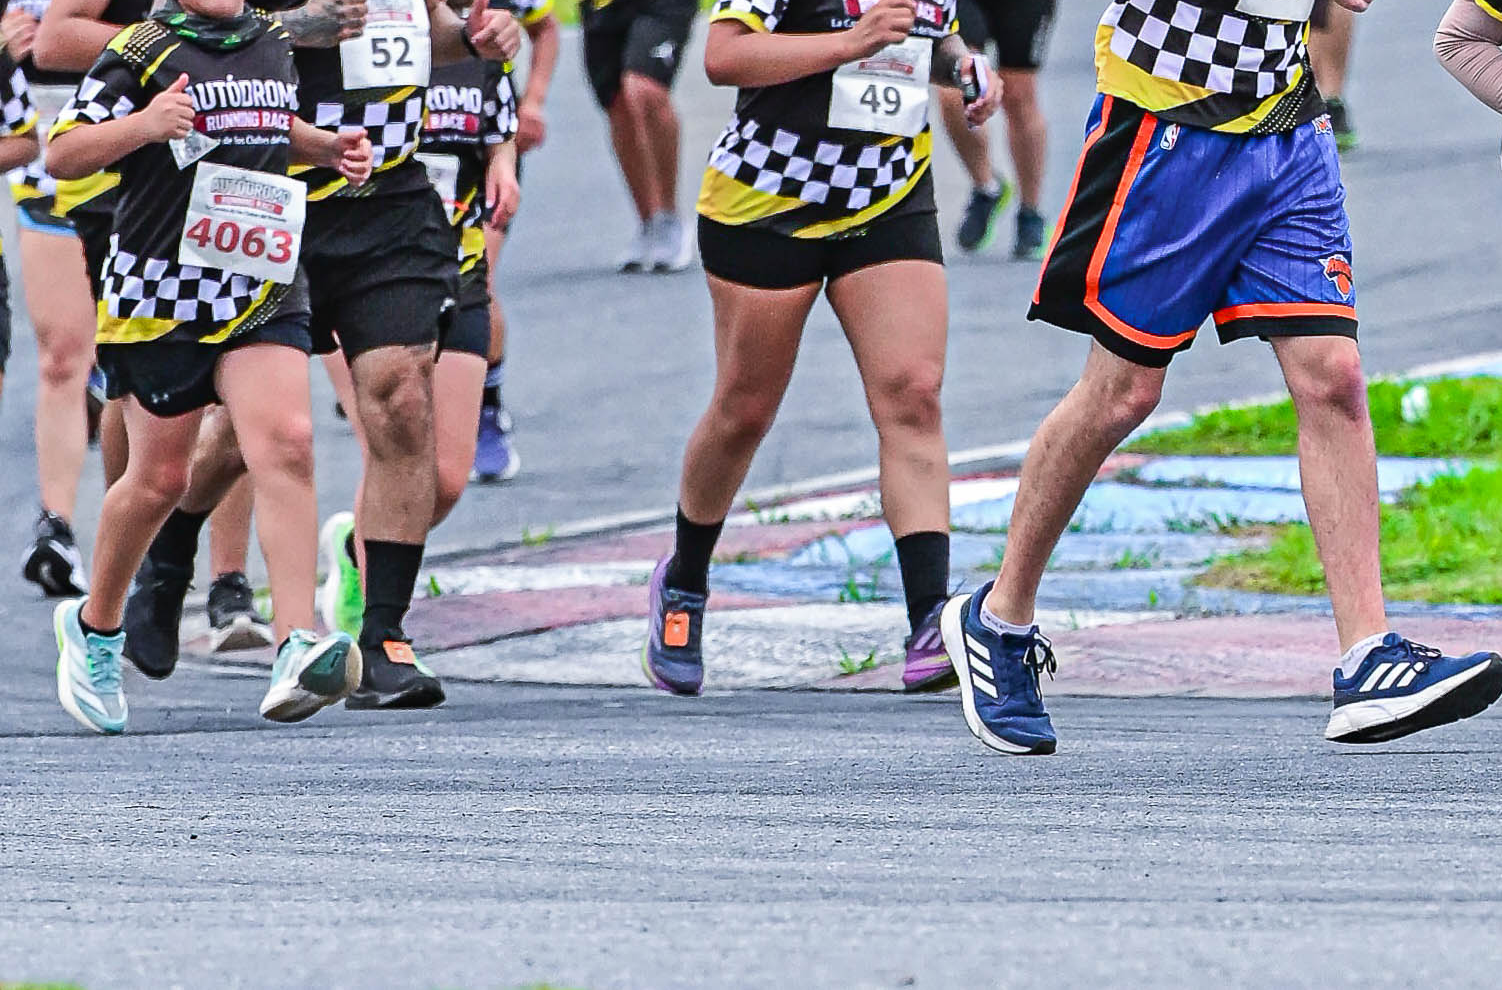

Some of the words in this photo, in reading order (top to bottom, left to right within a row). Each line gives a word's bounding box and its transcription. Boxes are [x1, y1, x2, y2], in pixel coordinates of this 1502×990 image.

[371, 36, 414, 68] 52
[185, 74, 300, 112] AUTÓDROM
[860, 84, 901, 116] 49
[205, 111, 260, 131] RUNNING
[262, 110, 290, 130] RACE
[186, 217, 293, 264] 4063
